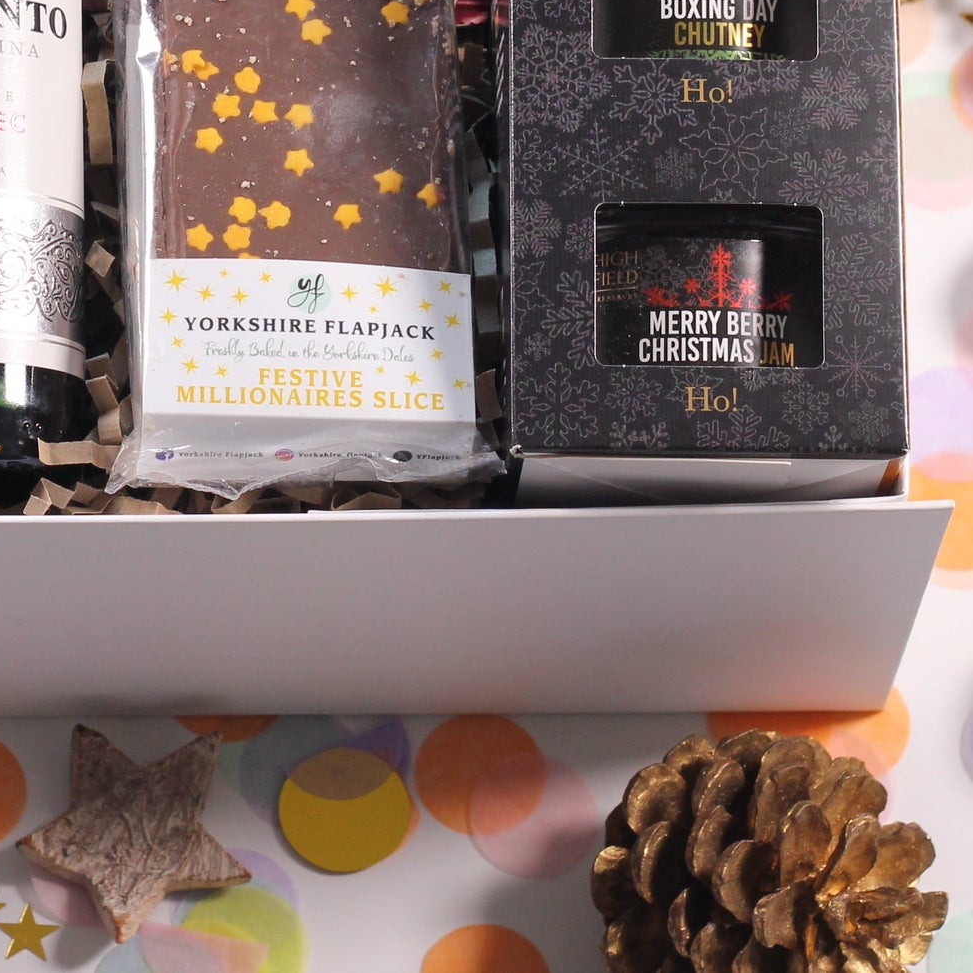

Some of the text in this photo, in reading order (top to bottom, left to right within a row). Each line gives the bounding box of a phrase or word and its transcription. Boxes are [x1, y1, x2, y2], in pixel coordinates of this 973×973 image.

[674, 22, 765, 48] CHUTNEY
[680, 78, 733, 104] Ho!
[184, 316, 435, 341] YORKSHIRE FLAPJACK
[649, 310, 788, 339] MERRY BERRY
[205, 338, 244, 363] Freshly
[248, 338, 286, 357] Baked
[302, 340, 320, 358] the
[322, 340, 379, 363] Yorkshire
[381, 346, 415, 363] Dales
[638, 338, 795, 367] CHRISTMAS JAM
[258, 368, 363, 388] FESTIVE
[176, 385, 445, 411] MILLIONAIRES SLICE
[685, 386, 738, 412] Ho!
[178, 450, 264, 459] Yorkshire Flapjack
